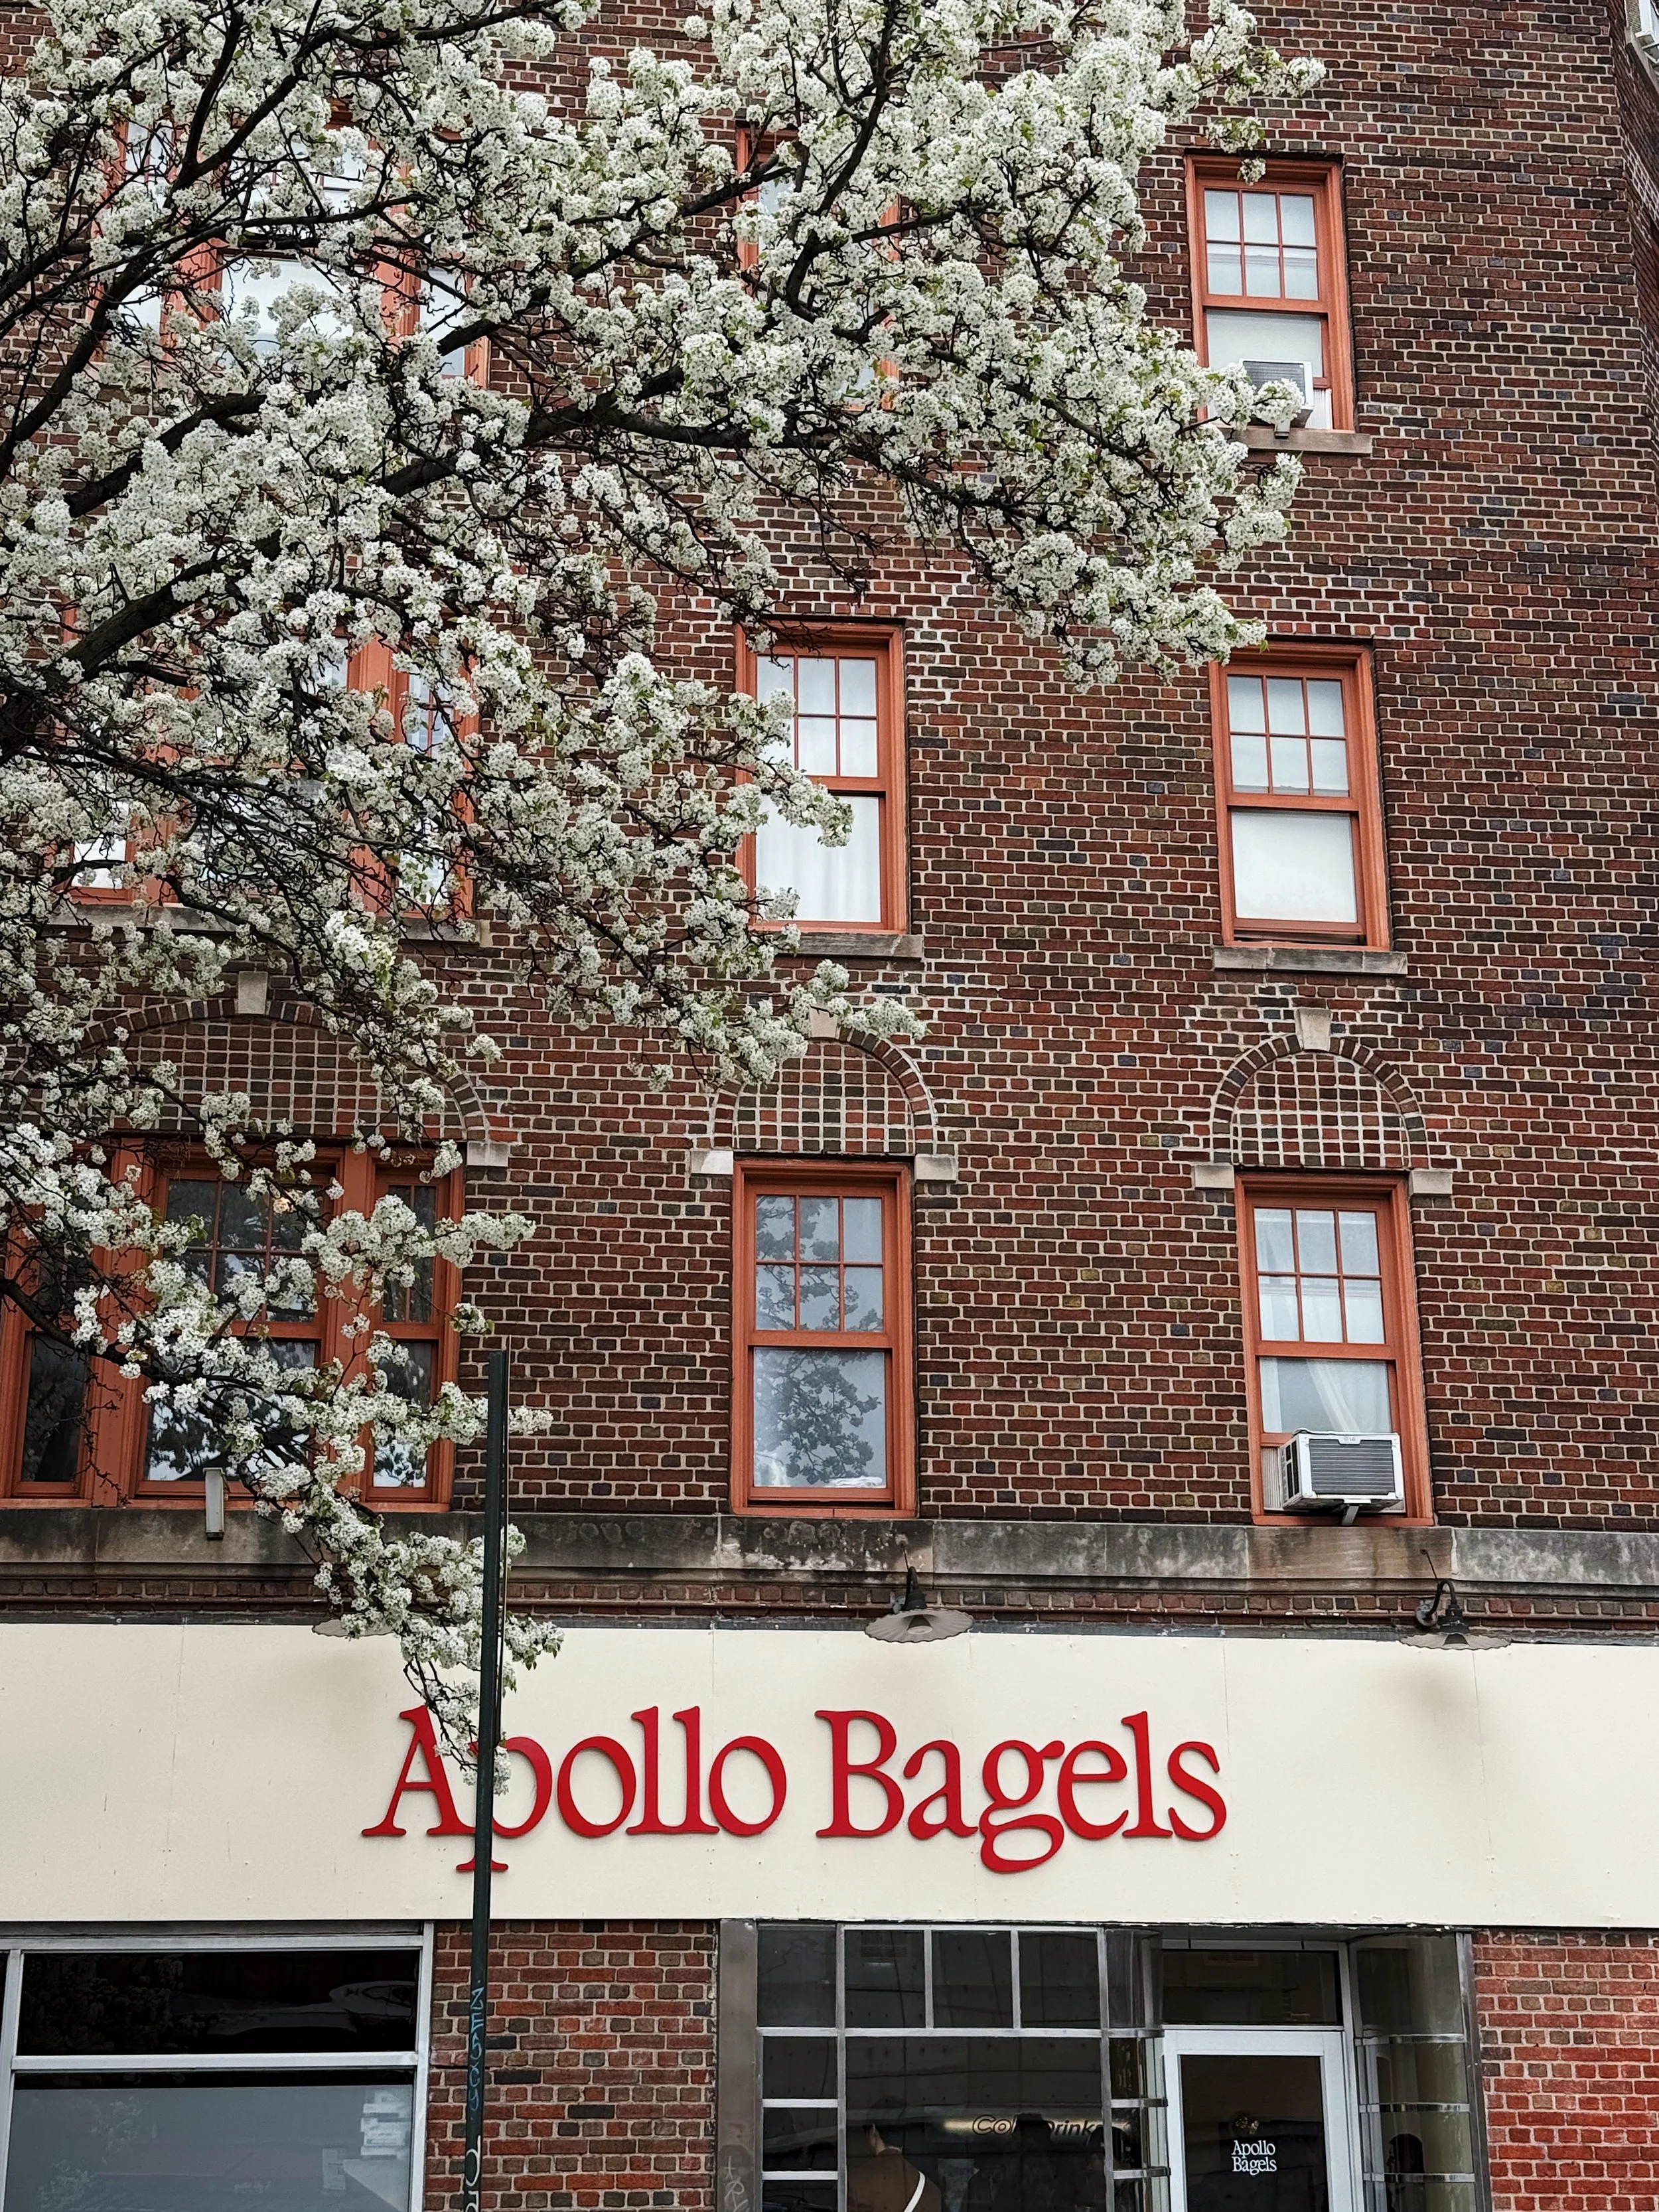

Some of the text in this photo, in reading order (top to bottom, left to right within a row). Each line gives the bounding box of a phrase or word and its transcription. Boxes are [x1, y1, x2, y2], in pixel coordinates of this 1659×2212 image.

[361, 1704, 1227, 1873] Apollo Bagels
[1048, 2119, 1103, 2136] rink
[1231, 2140, 1276, 2159] Apollo
[1231, 2156, 1277, 2176] Bagels
